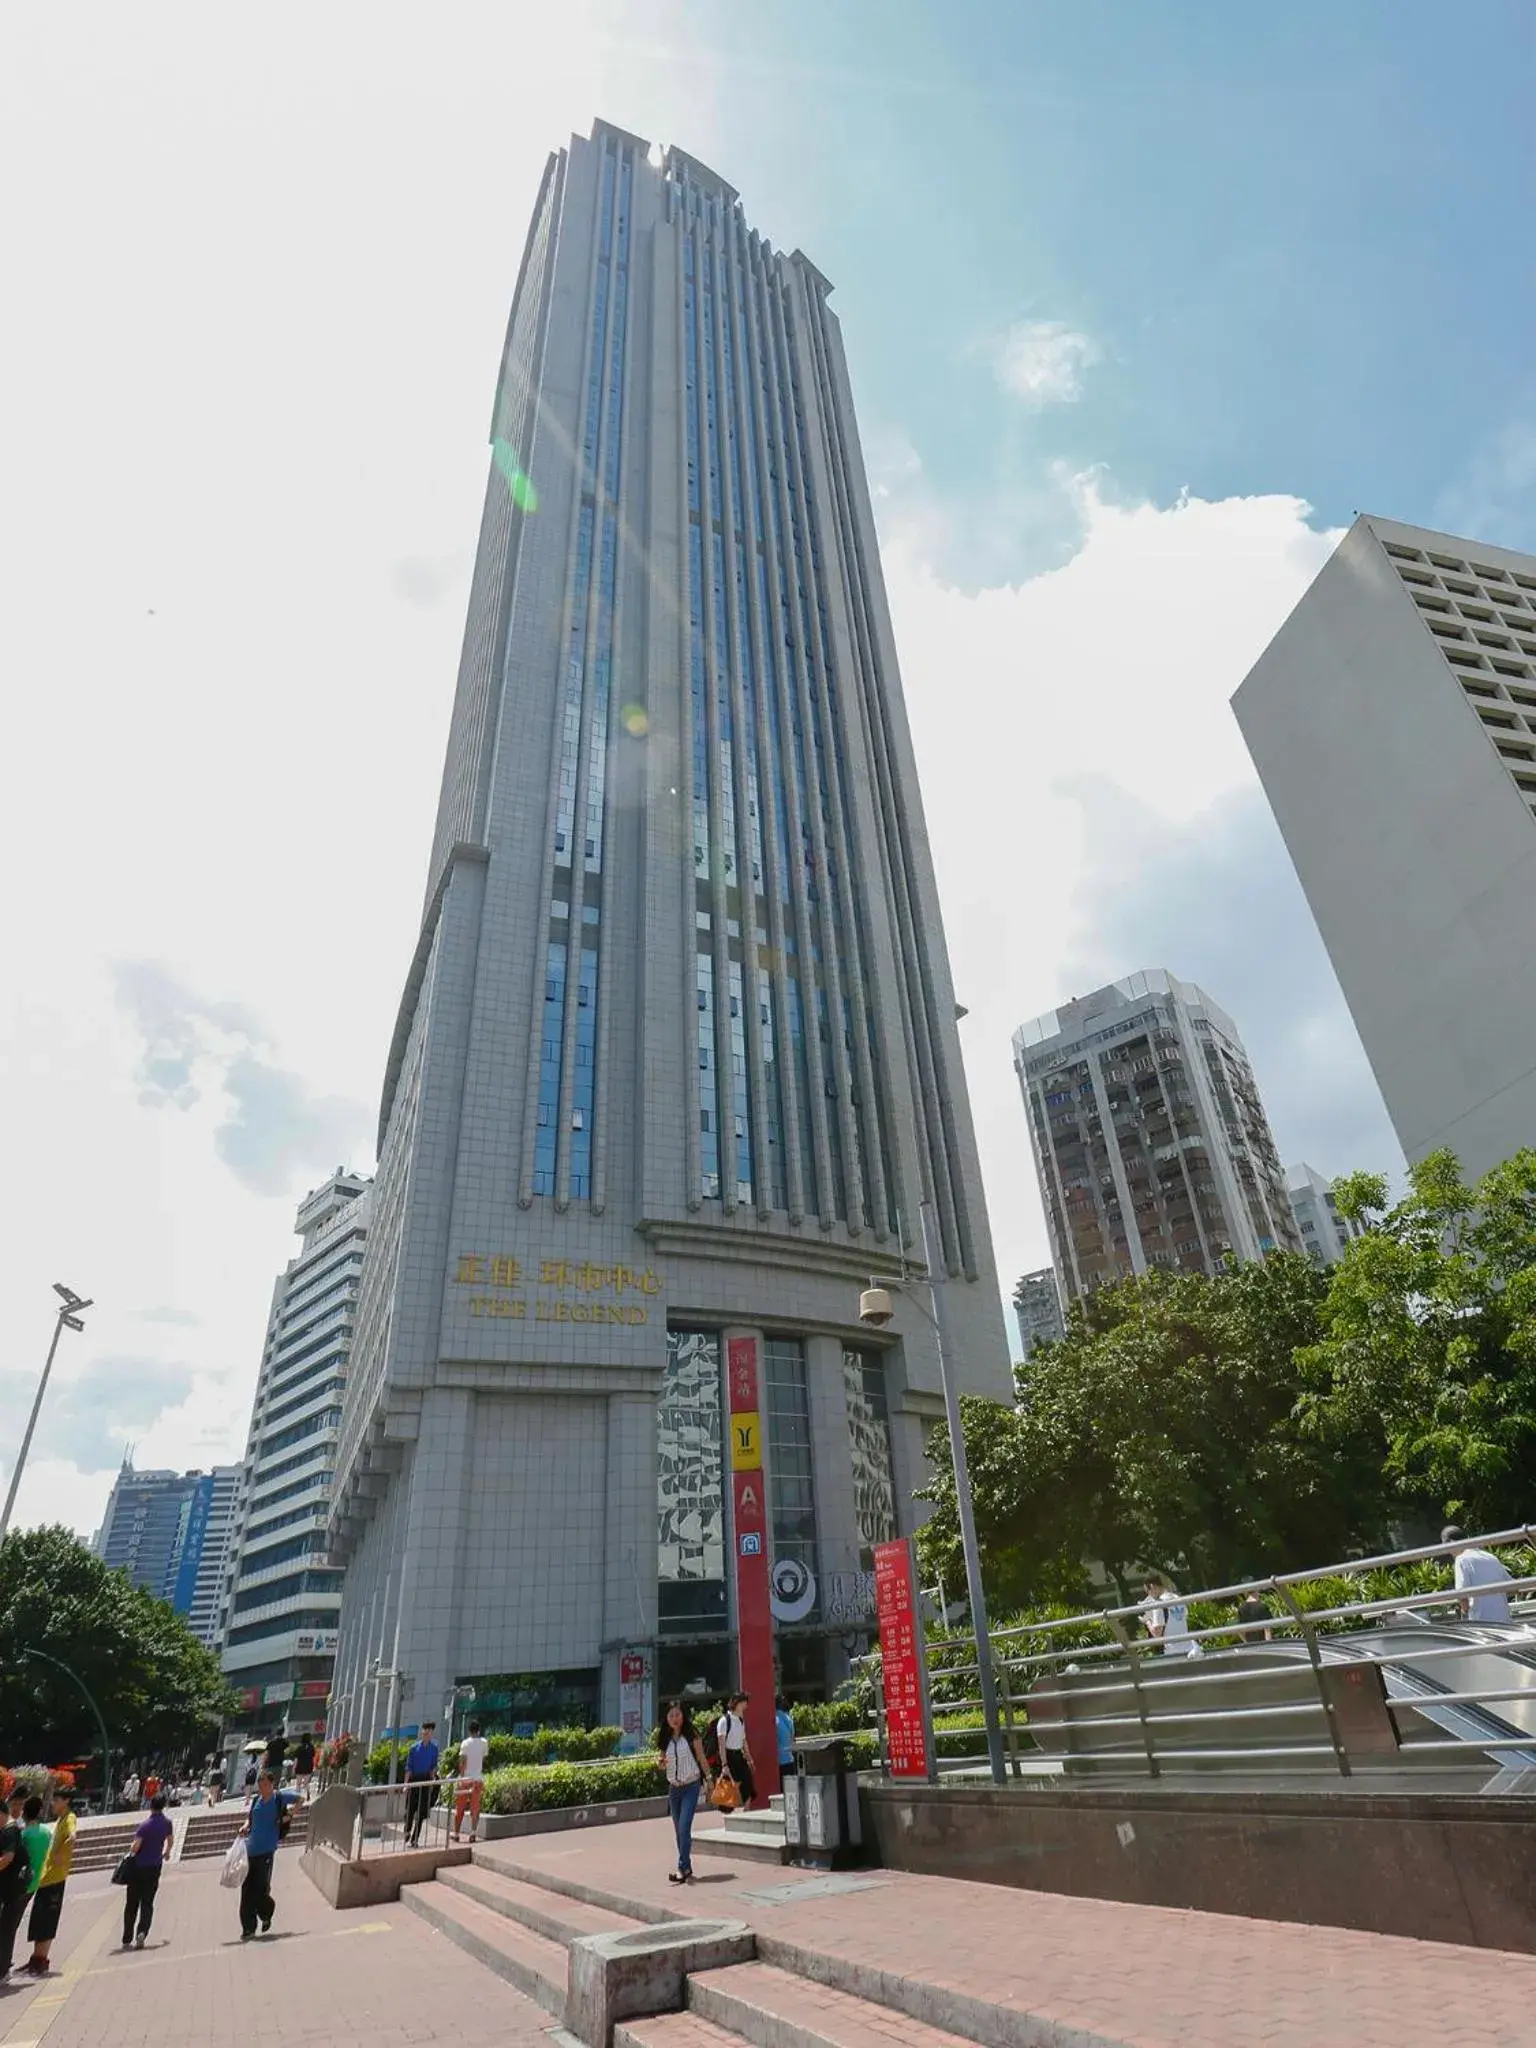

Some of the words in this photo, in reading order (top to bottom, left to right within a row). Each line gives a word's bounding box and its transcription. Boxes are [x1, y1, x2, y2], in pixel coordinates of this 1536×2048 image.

[469, 1297, 527, 1320] THE
[535, 1300, 648, 1326] LEGEND
[741, 1486, 756, 1506] A
